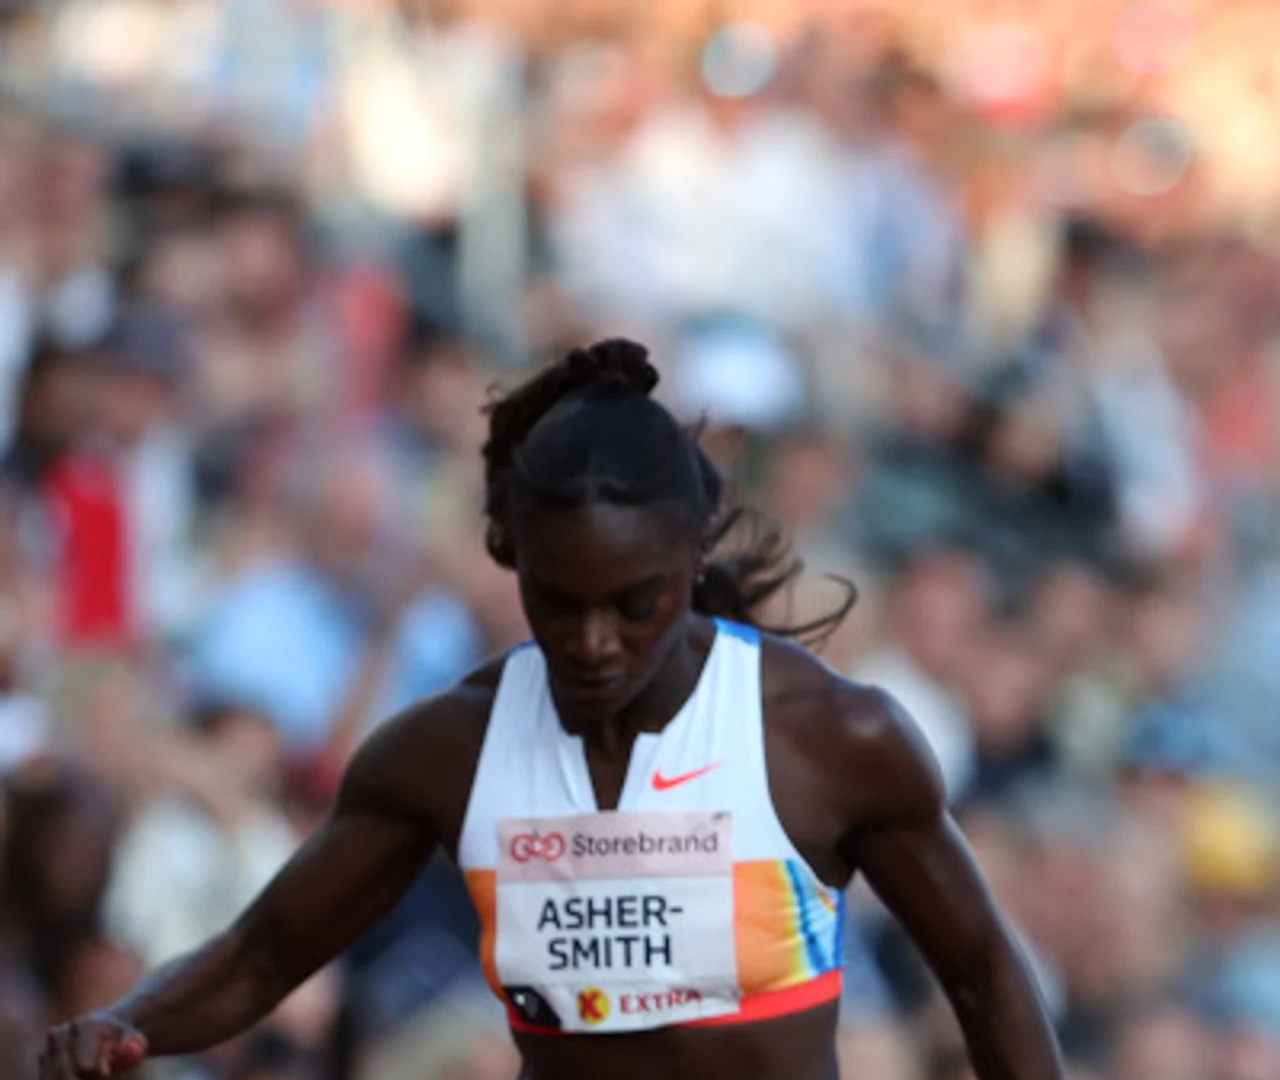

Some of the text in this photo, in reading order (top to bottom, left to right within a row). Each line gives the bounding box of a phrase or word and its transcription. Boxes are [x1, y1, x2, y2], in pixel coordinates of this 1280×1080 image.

[571, 833, 718, 858] Storebrand
[538, 896, 683, 931] ASHER-
[548, 935, 672, 970] SMITH
[619, 987, 704, 1015] EXTRA
